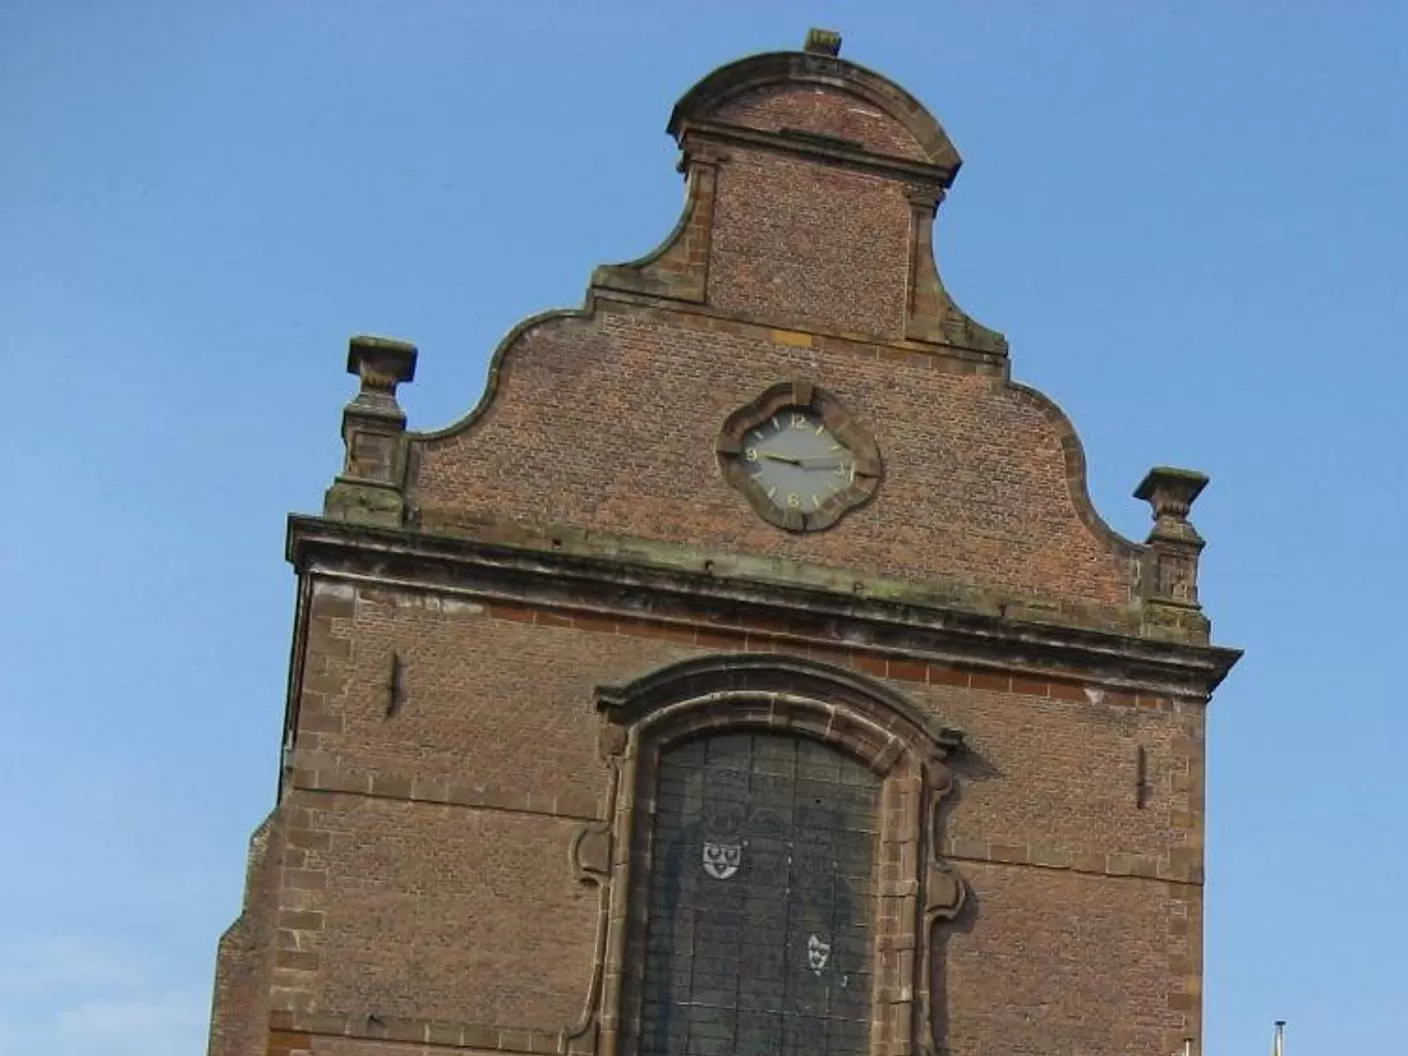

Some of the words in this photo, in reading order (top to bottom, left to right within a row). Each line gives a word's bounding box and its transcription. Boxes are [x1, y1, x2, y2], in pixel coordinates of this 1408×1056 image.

[791, 413, 806, 429] 12
[746, 448, 757, 461] 9
[787, 494, 800, 508] 6
